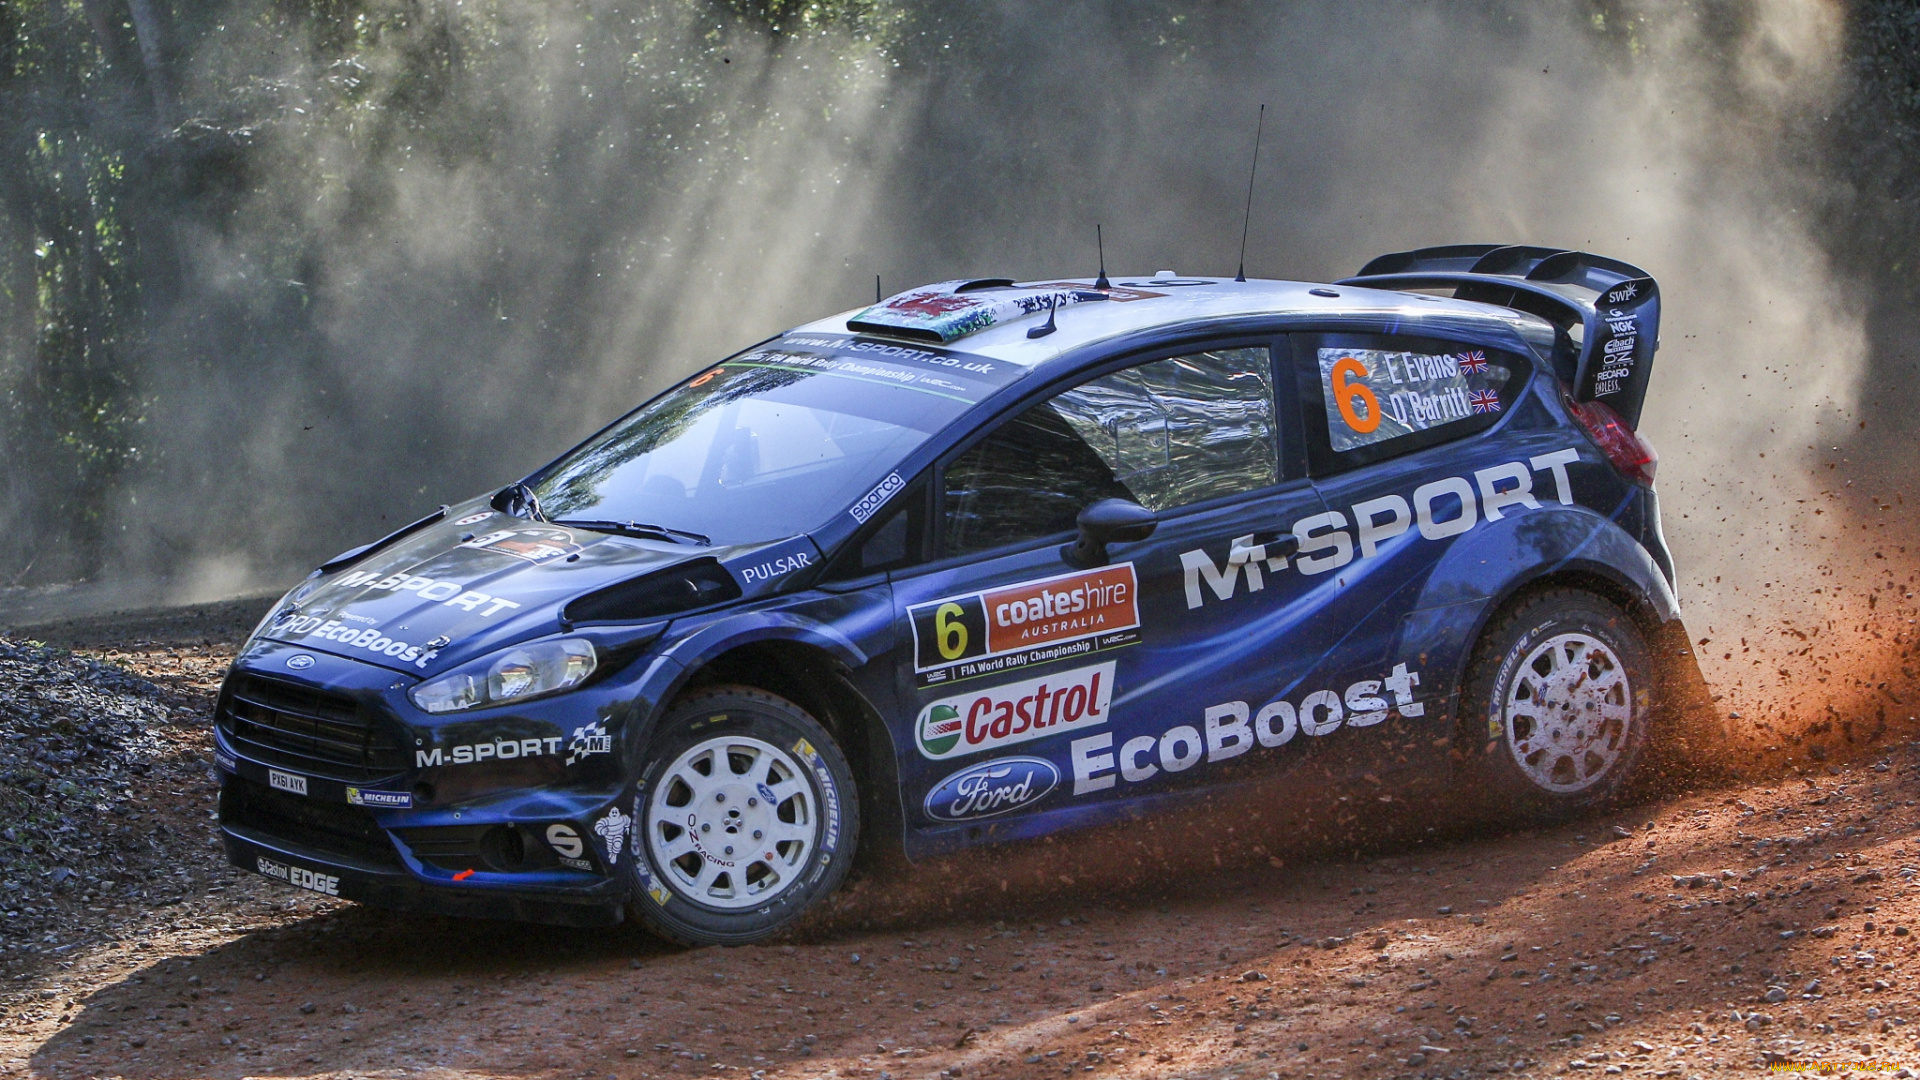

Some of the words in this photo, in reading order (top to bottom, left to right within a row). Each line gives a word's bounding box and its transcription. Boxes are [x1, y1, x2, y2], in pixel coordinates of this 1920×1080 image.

[1609, 290, 1632, 303] SWP
[1610, 320, 1635, 333] NGK
[783, 355, 816, 366] World
[838, 362, 914, 382] Championship
[1388, 353, 1403, 385] E
[1404, 352, 1457, 383] Evans
[1597, 368, 1629, 381] RECARO
[1331, 357, 1381, 434] 6
[1389, 393, 1408, 425] D
[1407, 387, 1471, 424] Barritt
[852, 474, 901, 518] sparco
[1179, 447, 1581, 610] M-SPORT
[742, 552, 812, 583] PULSAR
[332, 571, 521, 617] M-SPORT
[996, 579, 1126, 627] coateshire
[336, 611, 367, 624] Powered
[935, 602, 968, 660] 6
[1022, 614, 1104, 639] AUSTRALIA
[312, 620, 439, 669] EcoBoost
[961, 664, 976, 676] FIA
[978, 658, 1004, 672] World
[1006, 653, 1028, 668] Rally
[1030, 641, 1090, 662] Championship
[965, 671, 1101, 745] Castrol
[1070, 661, 1425, 796] EcoBoost
[415, 737, 563, 768] M-SPORT
[272, 773, 288, 788] PX61
[290, 776, 304, 792] AYK
[364, 793, 409, 804] MICHELIN
[950, 767, 1034, 817] Ford
[817, 767, 839, 850] MICHELIN
[694, 843, 735, 868] RACING
[264, 860, 288, 880] Castrol
[290, 866, 340, 896] EDGE
